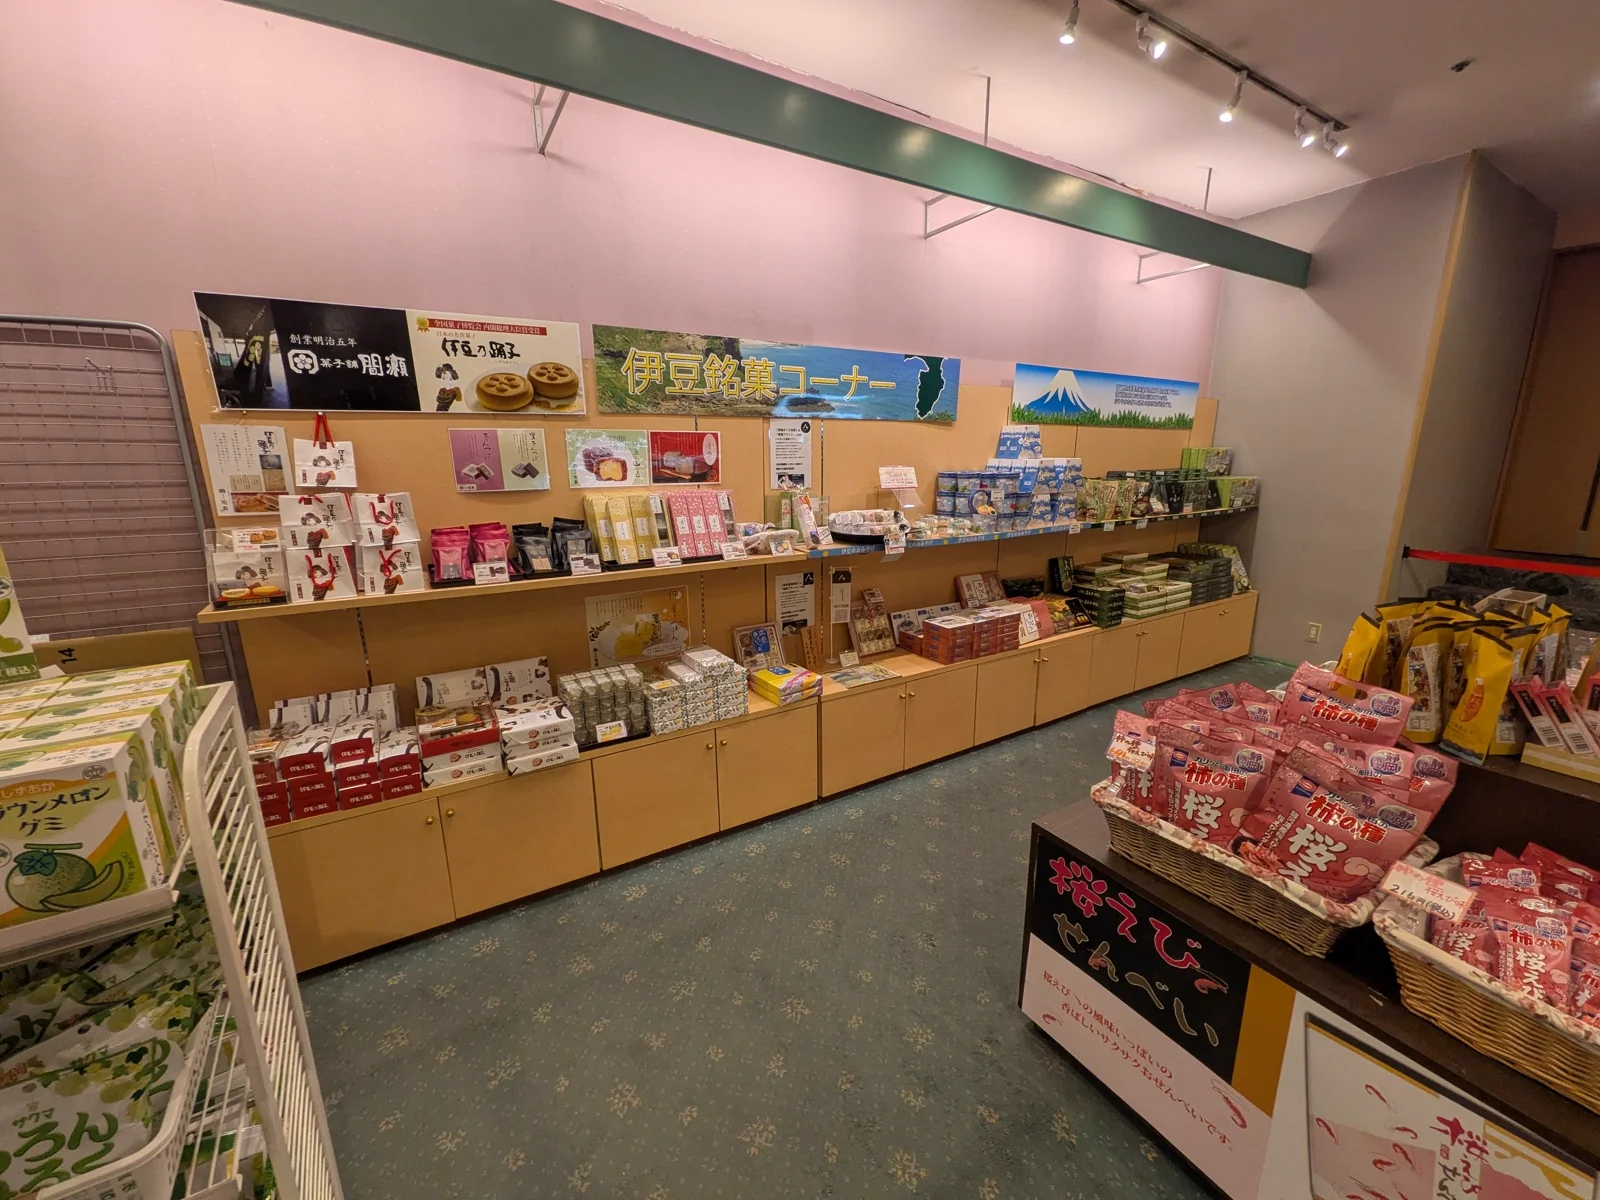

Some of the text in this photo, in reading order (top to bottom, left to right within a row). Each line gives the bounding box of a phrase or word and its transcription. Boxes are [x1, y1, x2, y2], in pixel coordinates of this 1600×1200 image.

[289, 333, 358, 348] 創業明治五年
[621, 346, 897, 401] 伊豆銘菓コーナー
[19, 816, 68, 837] グミ
[1305, 793, 1389, 845] 柿の種
[1049, 857, 1202, 969] 桜えび
[1053, 913, 1219, 1047] せんべい
